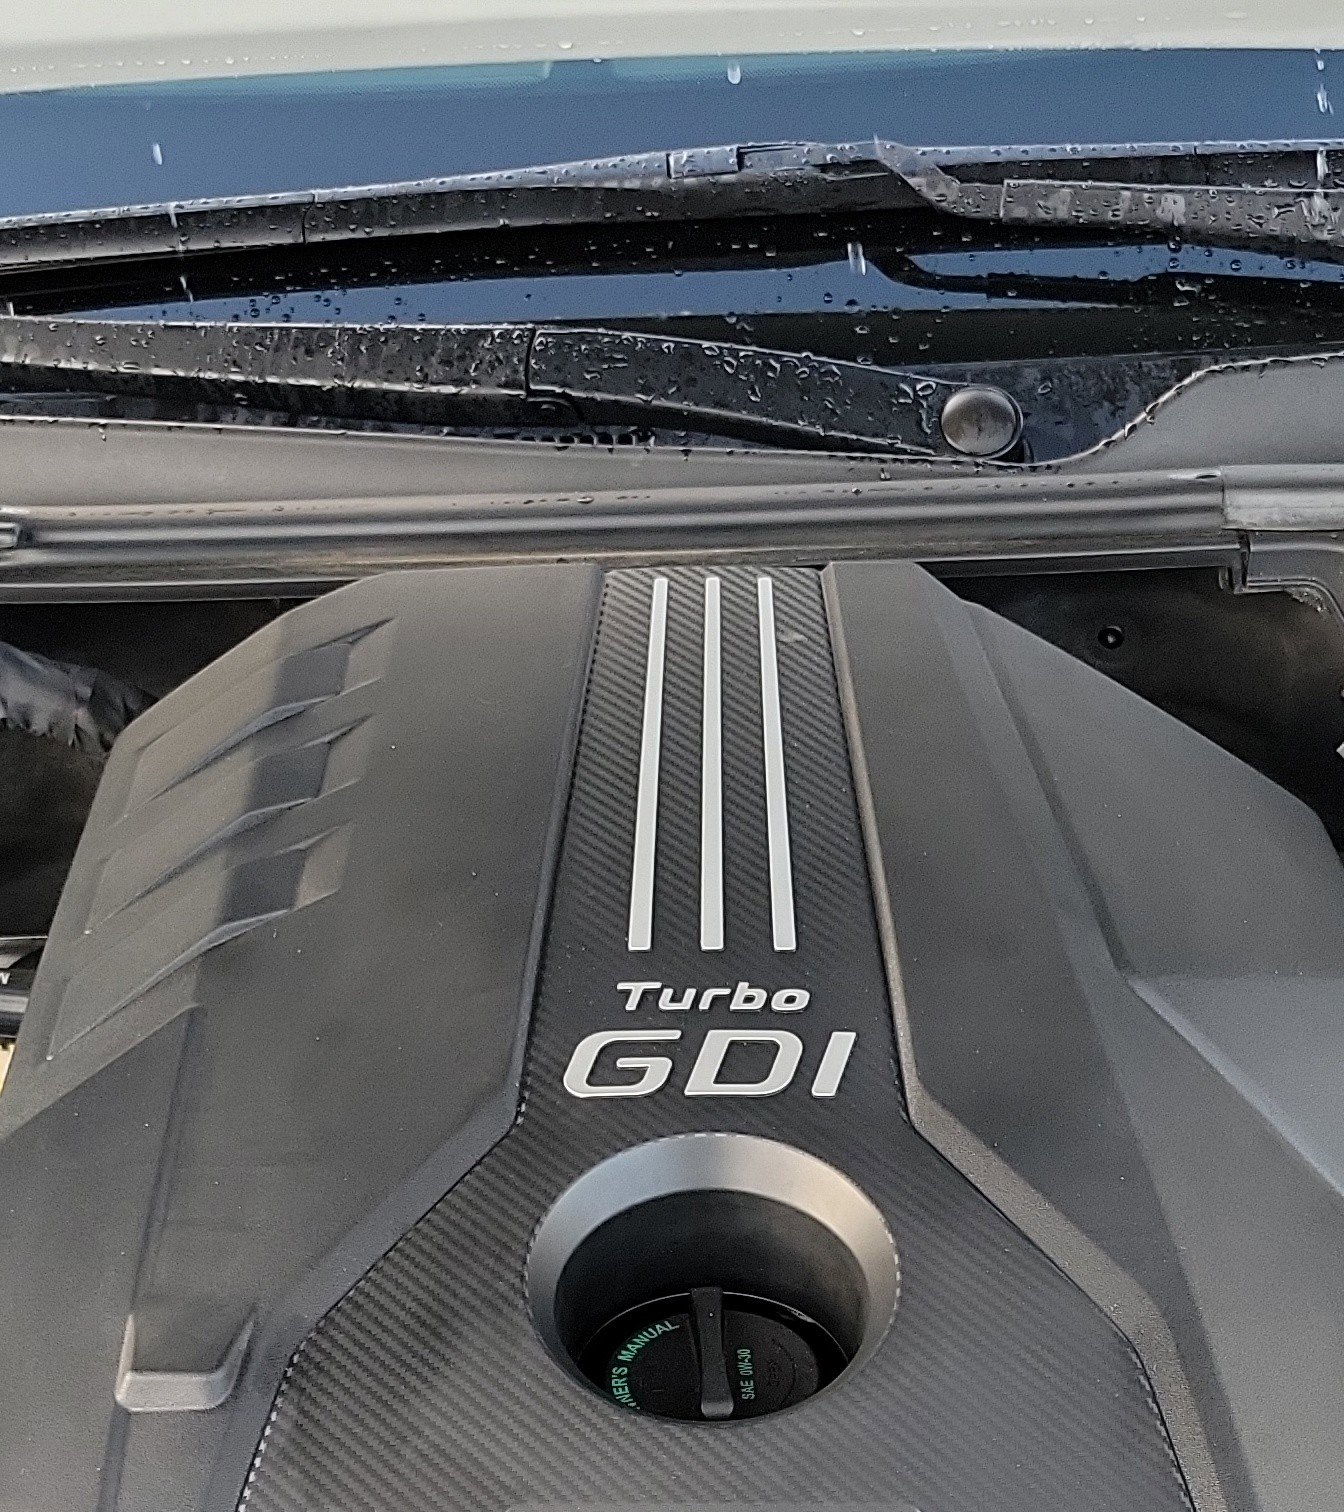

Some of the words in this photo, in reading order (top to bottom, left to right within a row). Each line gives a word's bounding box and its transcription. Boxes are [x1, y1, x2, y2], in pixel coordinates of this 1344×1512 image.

[616, 981, 811, 1013] Turbo
[563, 1029, 857, 1098] GDI
[617, 1319, 681, 1362] MANUAL
[736, 1348, 755, 1376] 0W-30
[741, 1379, 756, 1401] SAE
